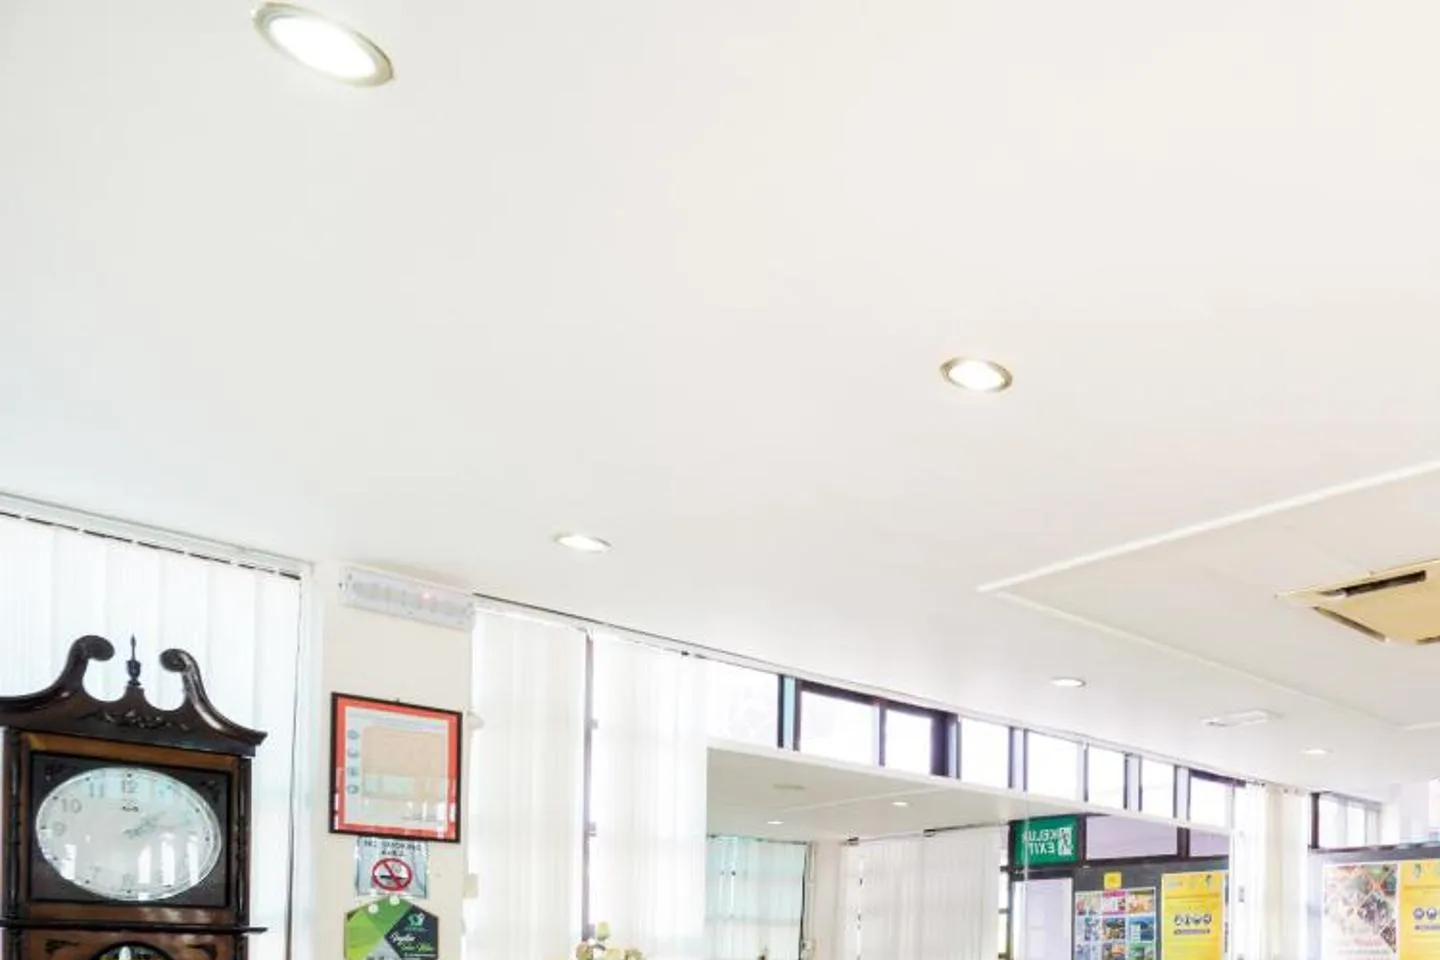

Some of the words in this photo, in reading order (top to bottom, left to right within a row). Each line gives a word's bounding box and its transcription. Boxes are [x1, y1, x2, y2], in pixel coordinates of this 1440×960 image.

[88, 781, 105, 798] 11
[121, 779, 139, 794] 12
[61, 798, 82, 814] 10
